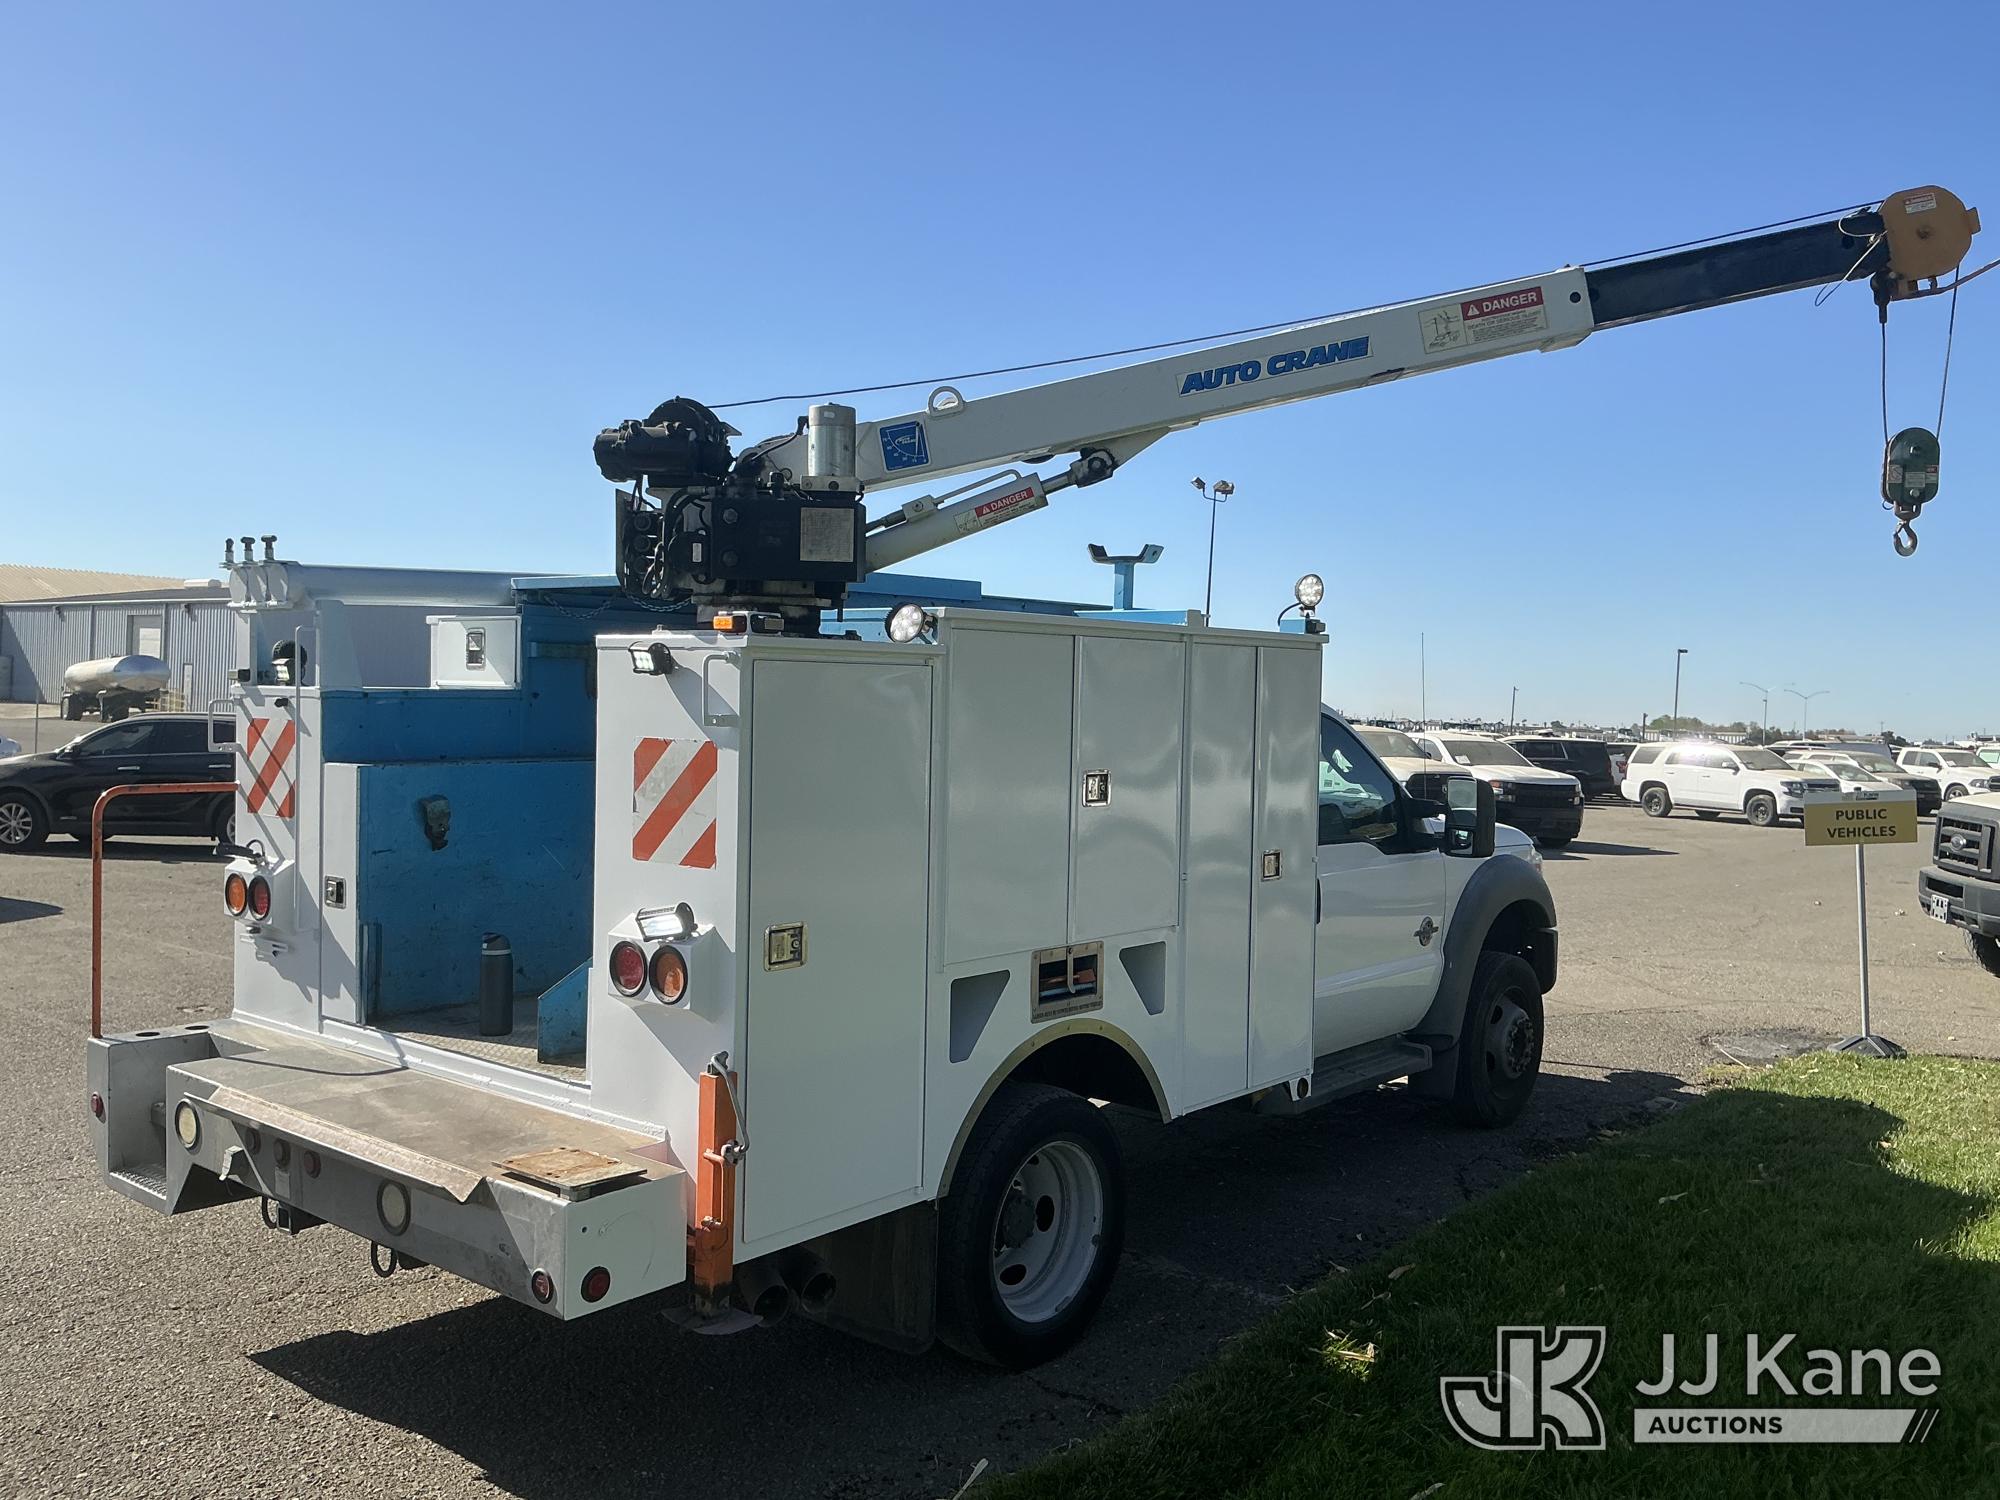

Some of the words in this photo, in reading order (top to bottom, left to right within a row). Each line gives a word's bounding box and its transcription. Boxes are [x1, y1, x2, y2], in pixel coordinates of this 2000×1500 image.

[1482, 292, 1537, 313] DANGER
[1180, 360, 1262, 395] AUTO
[1266, 336, 1370, 376] CRANE
[990, 490, 1028, 511] DANGER
[1835, 808, 1888, 821] PUBLIC
[1827, 826, 1897, 839] VEHICLES
